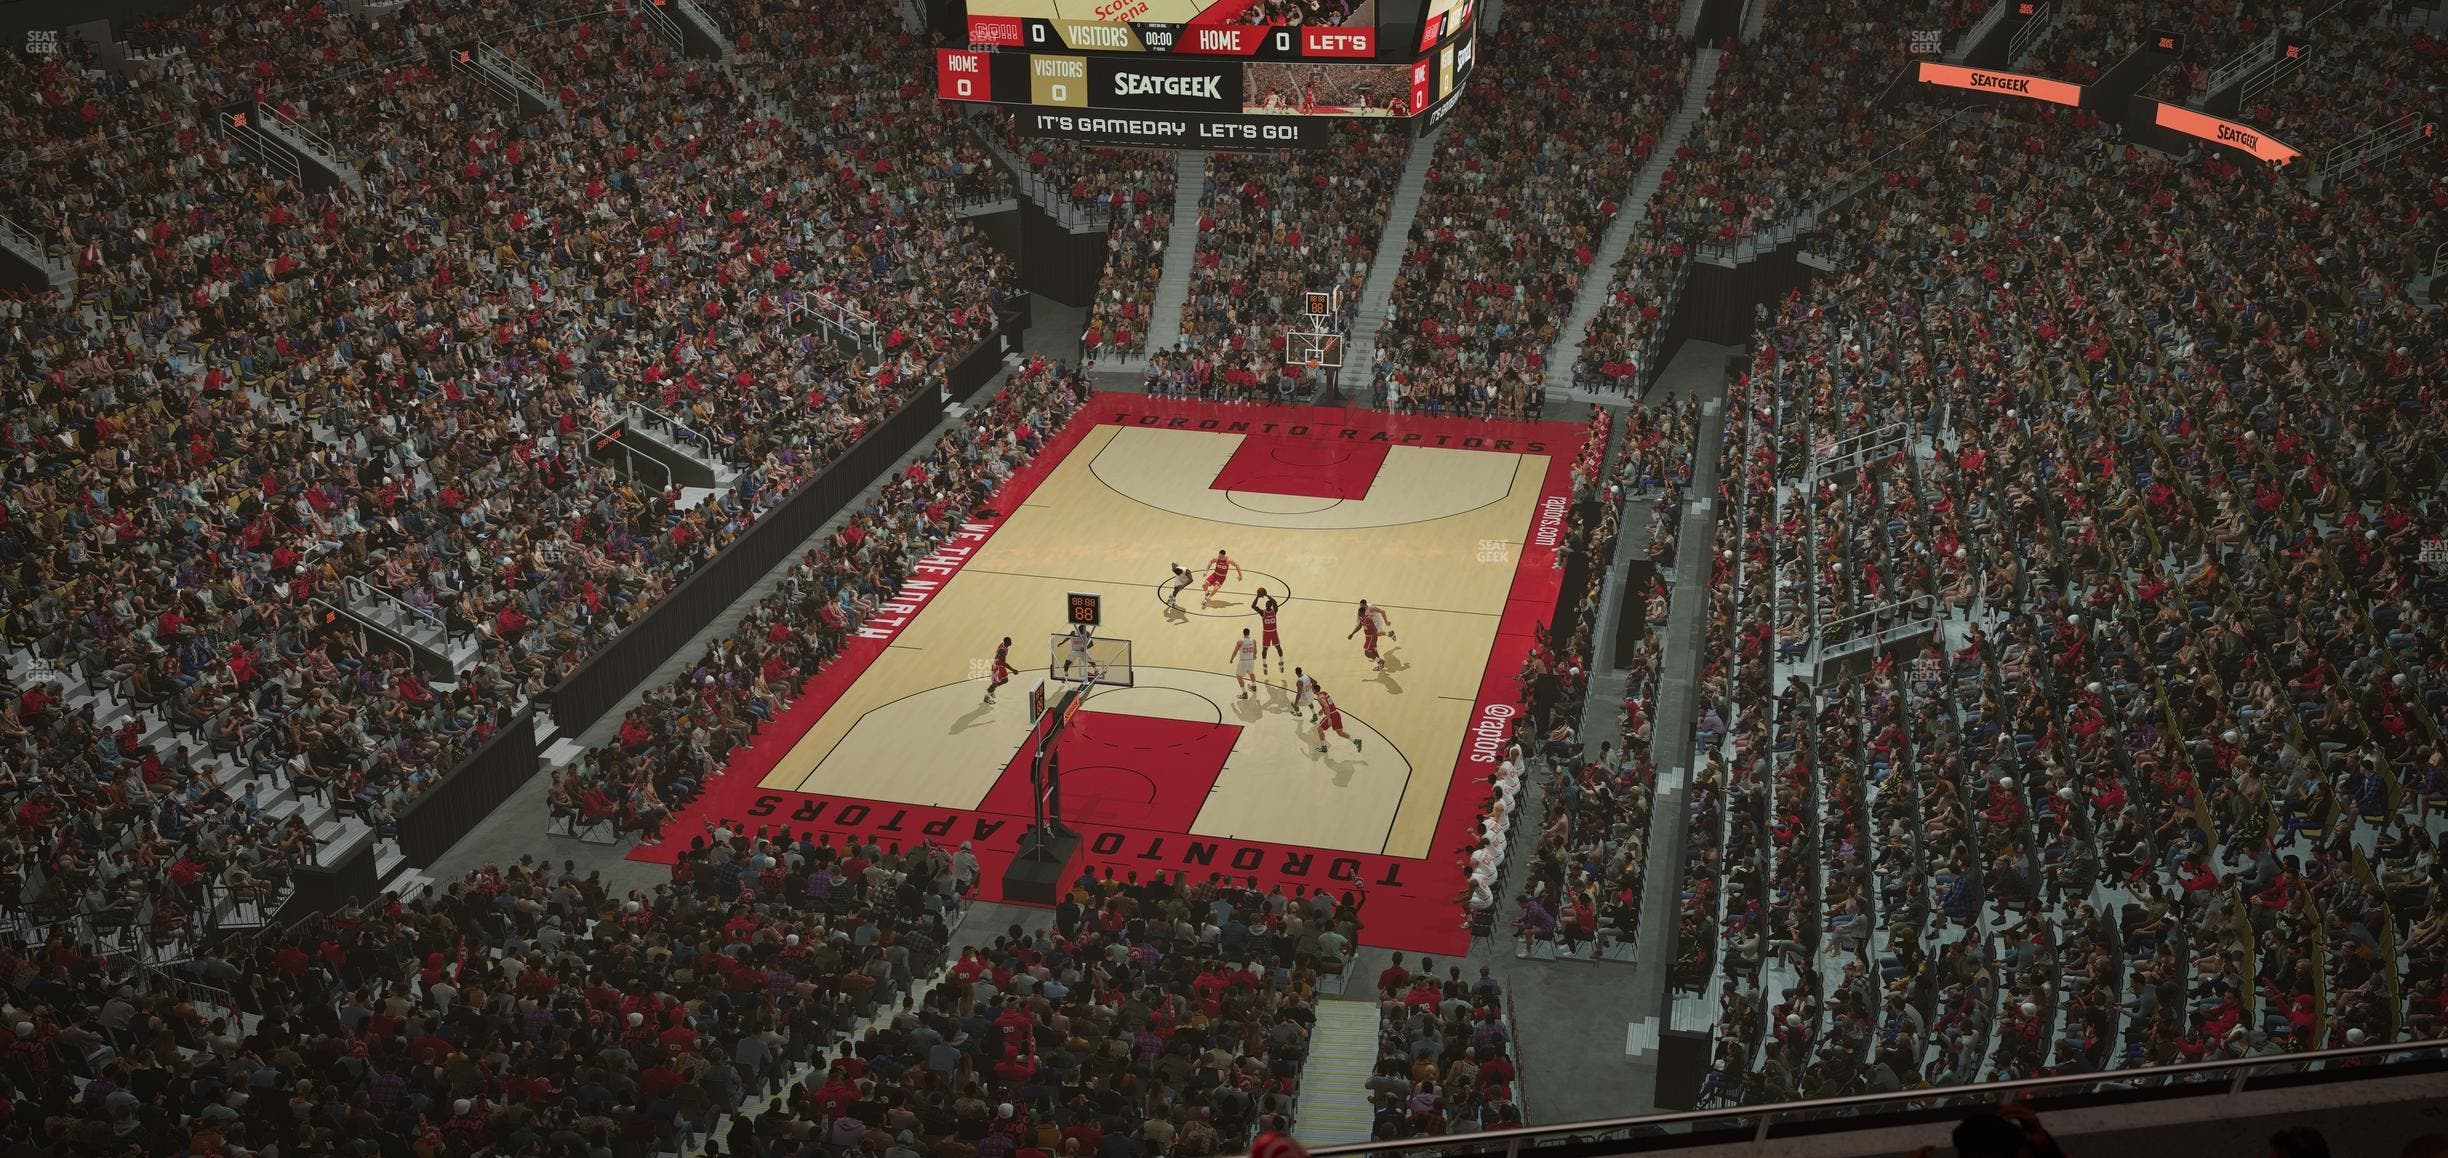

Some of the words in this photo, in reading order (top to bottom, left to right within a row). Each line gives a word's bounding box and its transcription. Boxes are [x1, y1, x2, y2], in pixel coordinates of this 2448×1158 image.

[1032, 24, 1045, 42] 0
[1068, 25, 1128, 47] VISITORS
[1145, 31, 1172, 46] 00:00
[1200, 30, 1241, 51] HOME
[1276, 33, 1290, 51] 0
[1309, 35, 1367, 51] LET'S
[949, 54, 978, 73] HOME
[1034, 60, 1083, 78] VISITORS
[957, 79, 972, 96] 0
[1052, 84, 1067, 101] 0
[1114, 72, 1222, 100] SEATGEEK
[1970, 72, 2029, 93] SEATGEEK
[1037, 115, 1073, 131] IT'S
[1078, 117, 1186, 136] GAMEDAY
[1199, 122, 1257, 139] LET'S
[1262, 125, 1299, 140] GO!
[2217, 124, 2259, 151] SEATGEEK
[1114, 413, 1309, 435] TORONTO
[1337, 429, 1547, 451] RAPTORS
[1535, 496, 1567, 545] raptors.com
[959, 523, 994, 541] WE
[914, 546, 971, 576] THE
[847, 579, 939, 640] NORTH
[1072, 597, 1083, 606] 88
[1075, 607, 1094, 621] 88
[1471, 703, 1516, 763] @raptors
[1090, 832, 1404, 887] TORONTO
[1003, 1025, 1015, 1034] 00
